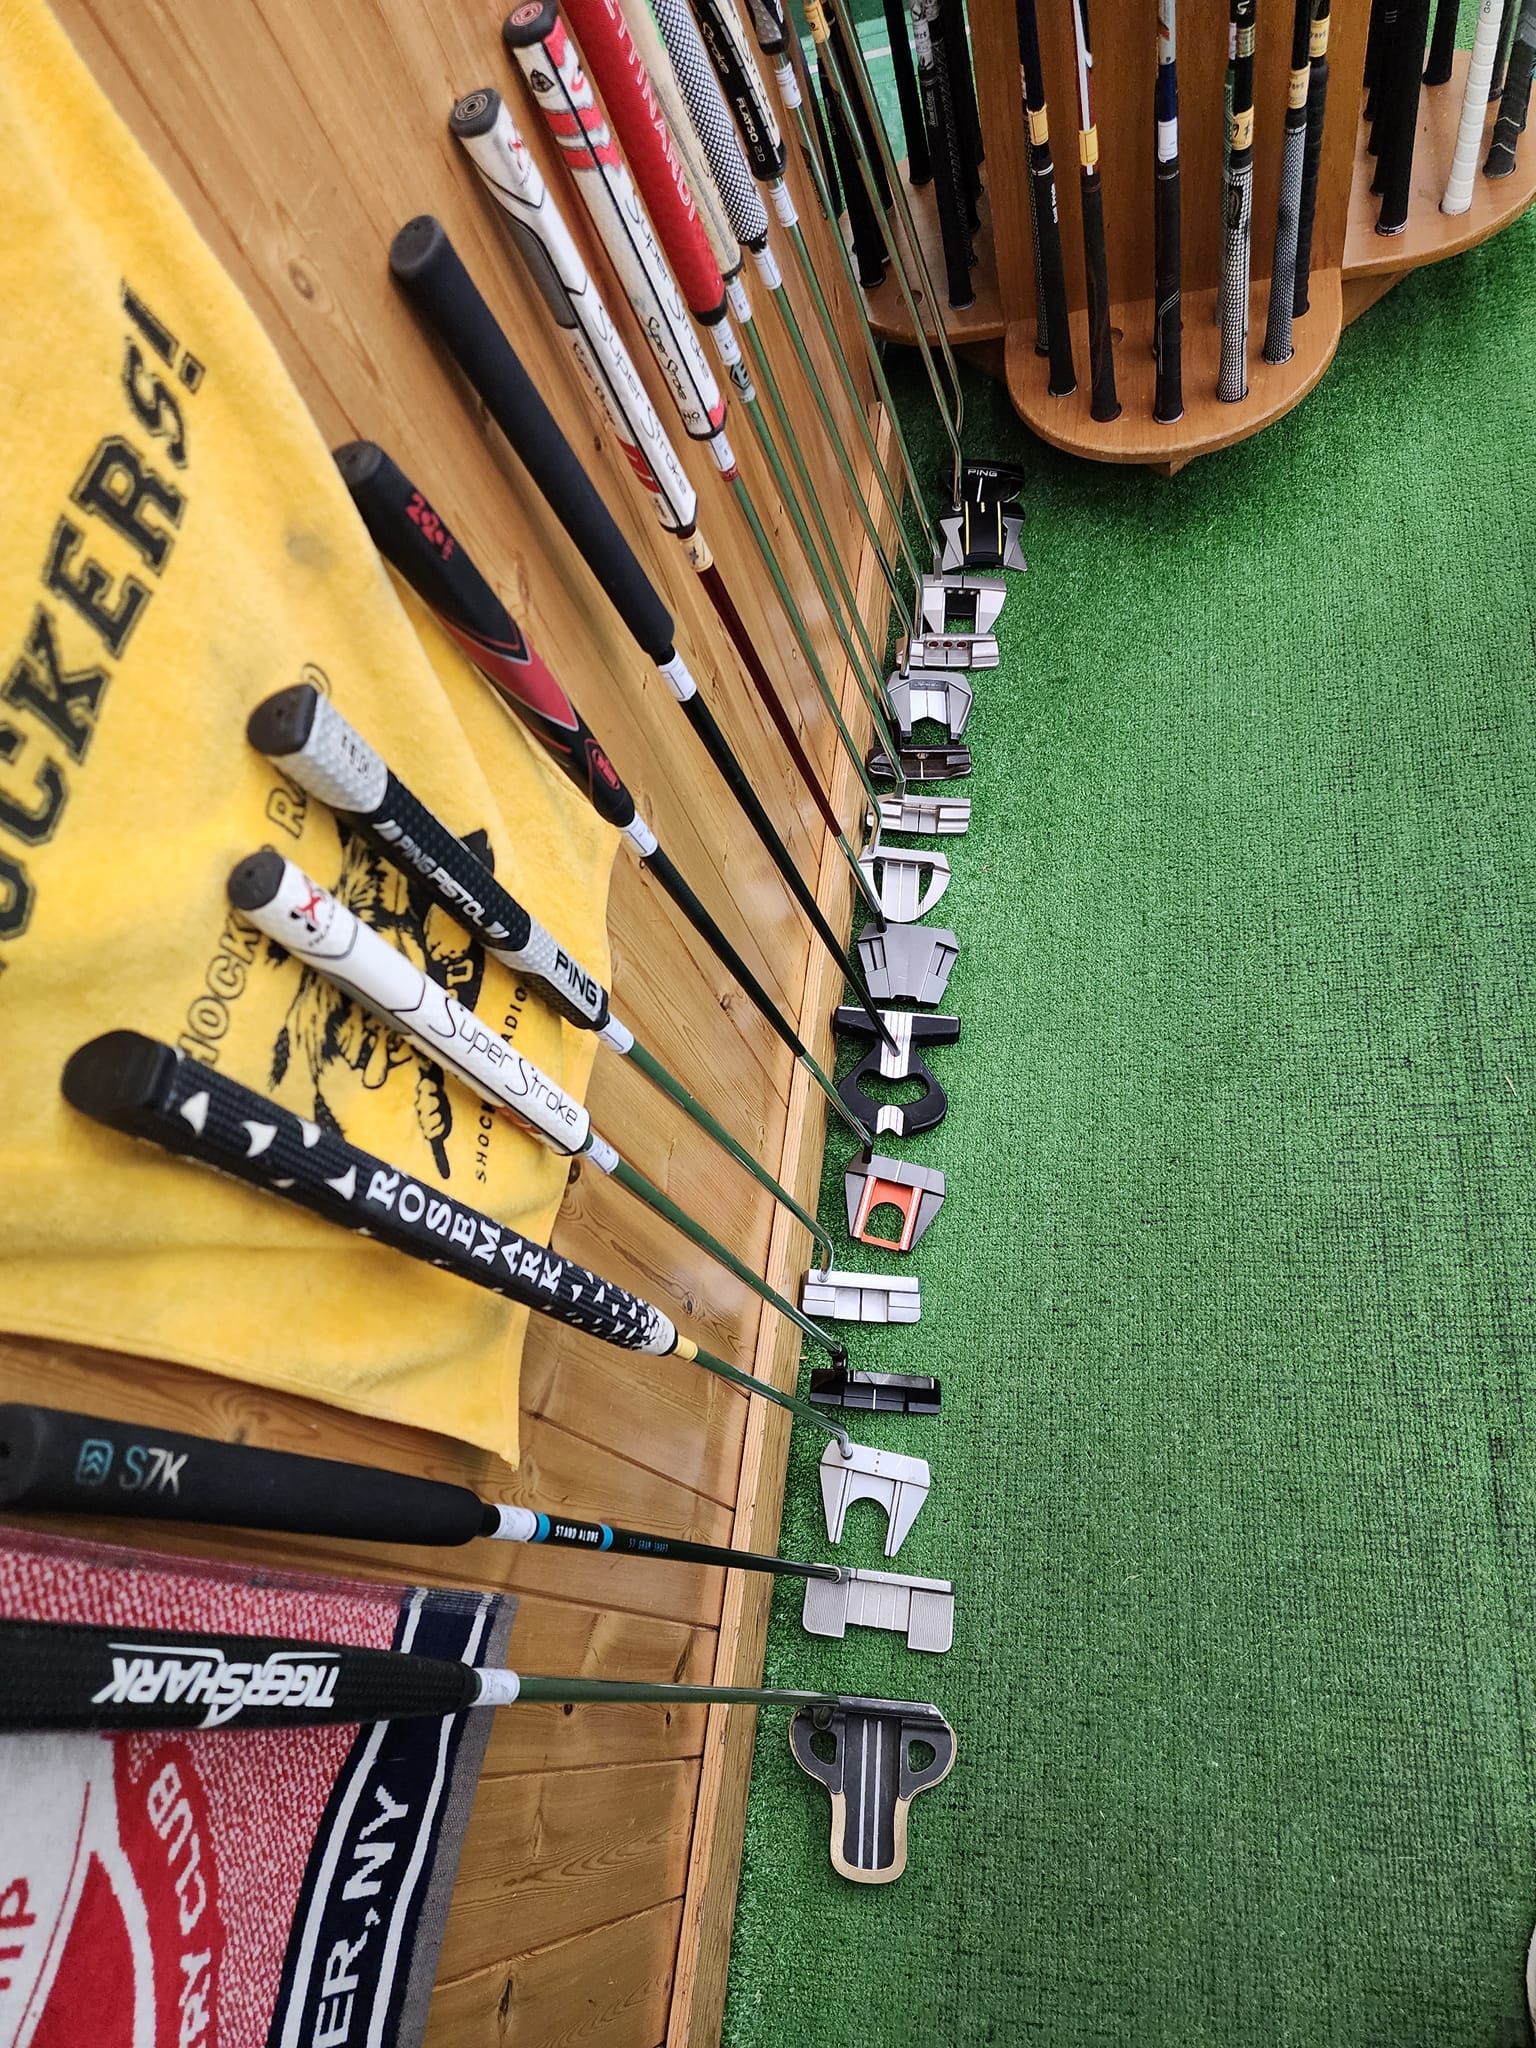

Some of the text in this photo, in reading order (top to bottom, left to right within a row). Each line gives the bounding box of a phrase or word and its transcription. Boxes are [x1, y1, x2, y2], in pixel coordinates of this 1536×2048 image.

[736, 97, 758, 143] FLATSO
[967, 468, 998, 478] PING
[398, 835, 438, 874] PING
[427, 865, 487, 928] PISTOL
[554, 949, 600, 1007] PING
[366, 1169, 562, 1295] ROSEMARK
[119, 1444, 189, 1495] S7K
[555, 1524, 599, 1543] STAND ALONE
[147, 1762, 207, 1936] CLUB
